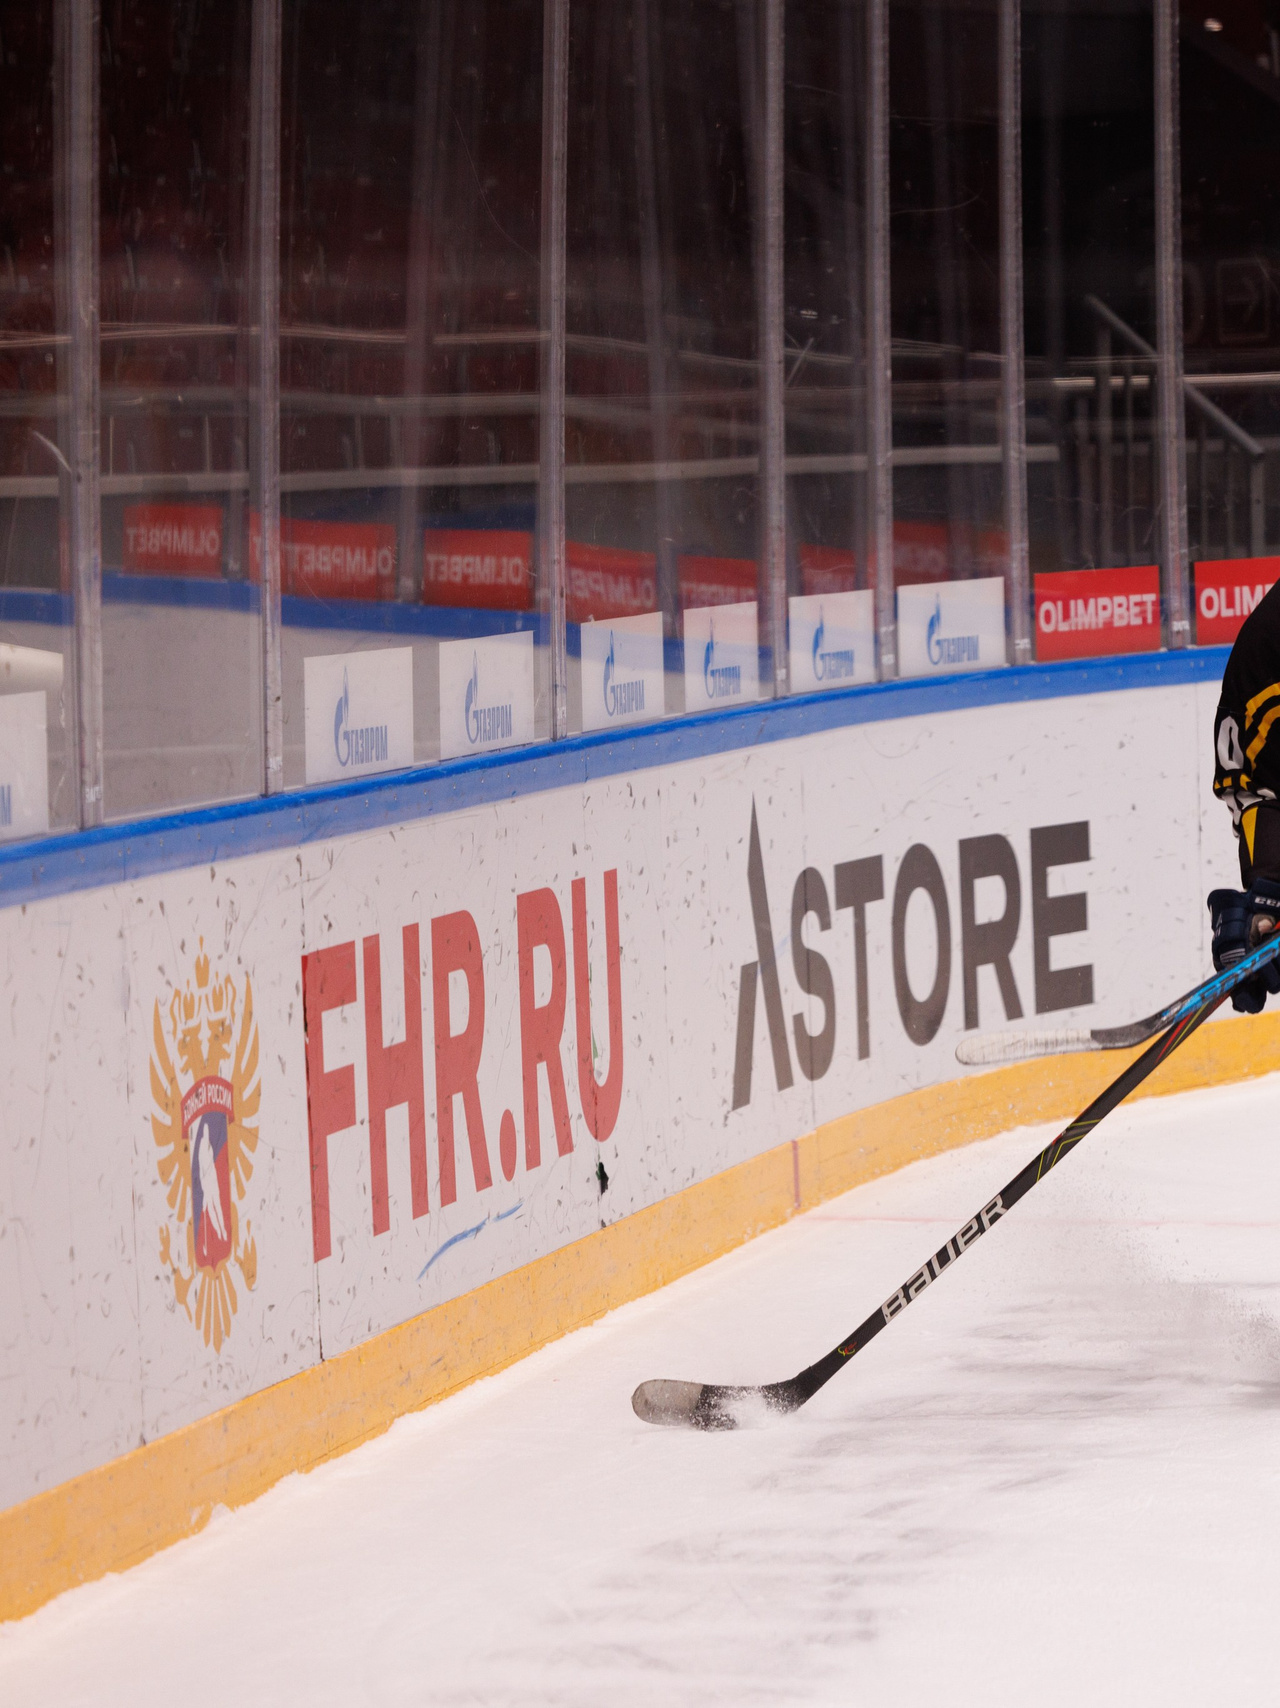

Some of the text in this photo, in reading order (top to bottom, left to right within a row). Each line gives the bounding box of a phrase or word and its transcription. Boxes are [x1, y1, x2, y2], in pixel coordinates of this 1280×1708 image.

[1039, 593, 1157, 633] OLIMPBET
[1200, 583, 1275, 619] OLIM
[616, 679, 645, 716] ГАЗПРОМ
[479, 704, 512, 743] ГАЗПРОМ
[350, 725, 388, 766] ГАЗПРОМ
[731, 791, 1095, 1112] ASTORE
[301, 868, 624, 1264] FHR.RU
[207, 1084, 232, 1111] РОССИИ
[881, 1194, 1008, 1324] BAUER
